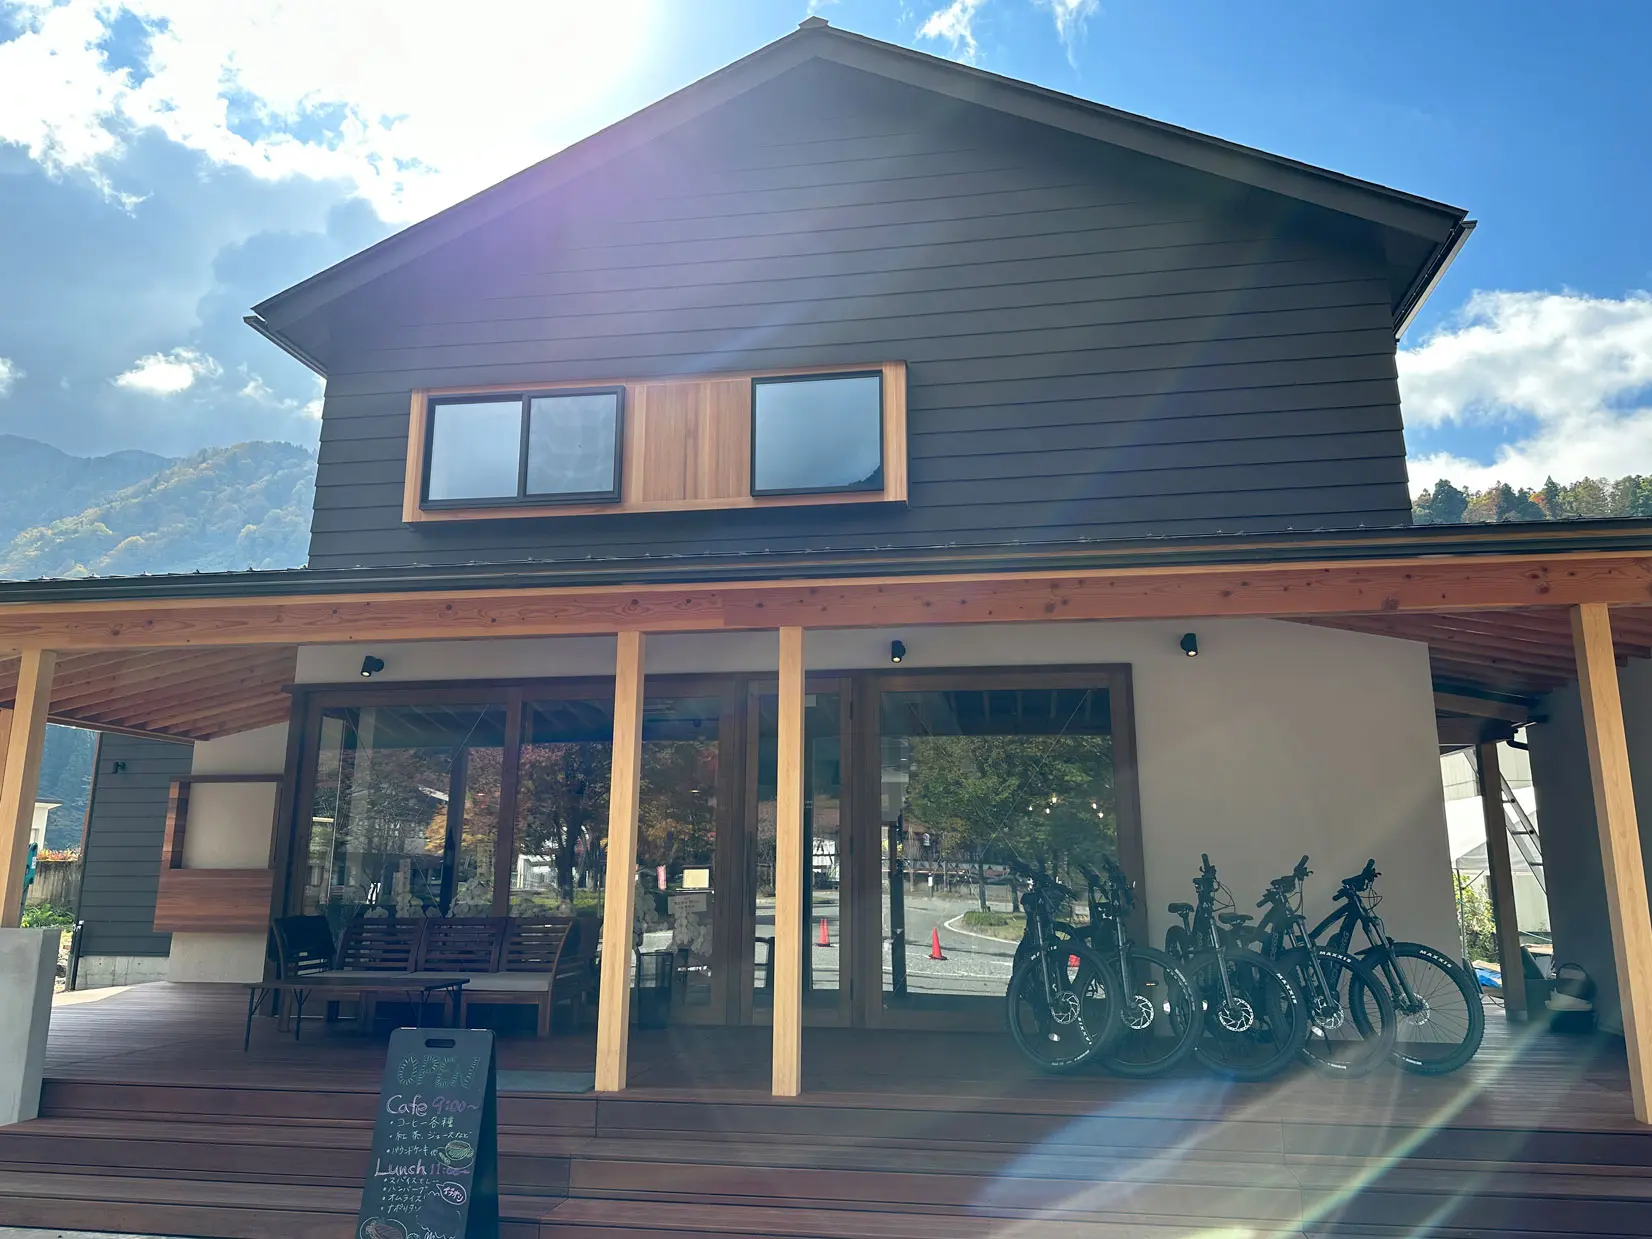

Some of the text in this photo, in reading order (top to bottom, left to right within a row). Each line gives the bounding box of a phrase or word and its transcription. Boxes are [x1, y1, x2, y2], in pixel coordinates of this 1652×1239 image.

[1319, 951, 1352, 963] MAXXIS
[1419, 949, 1453, 968] MAXXIS
[1276, 973, 1298, 1004] MAXXIS
[397, 1054, 481, 1089] OPEN
[386, 1093, 428, 1116] Cafe
[374, 1157, 427, 1177] Lunch
